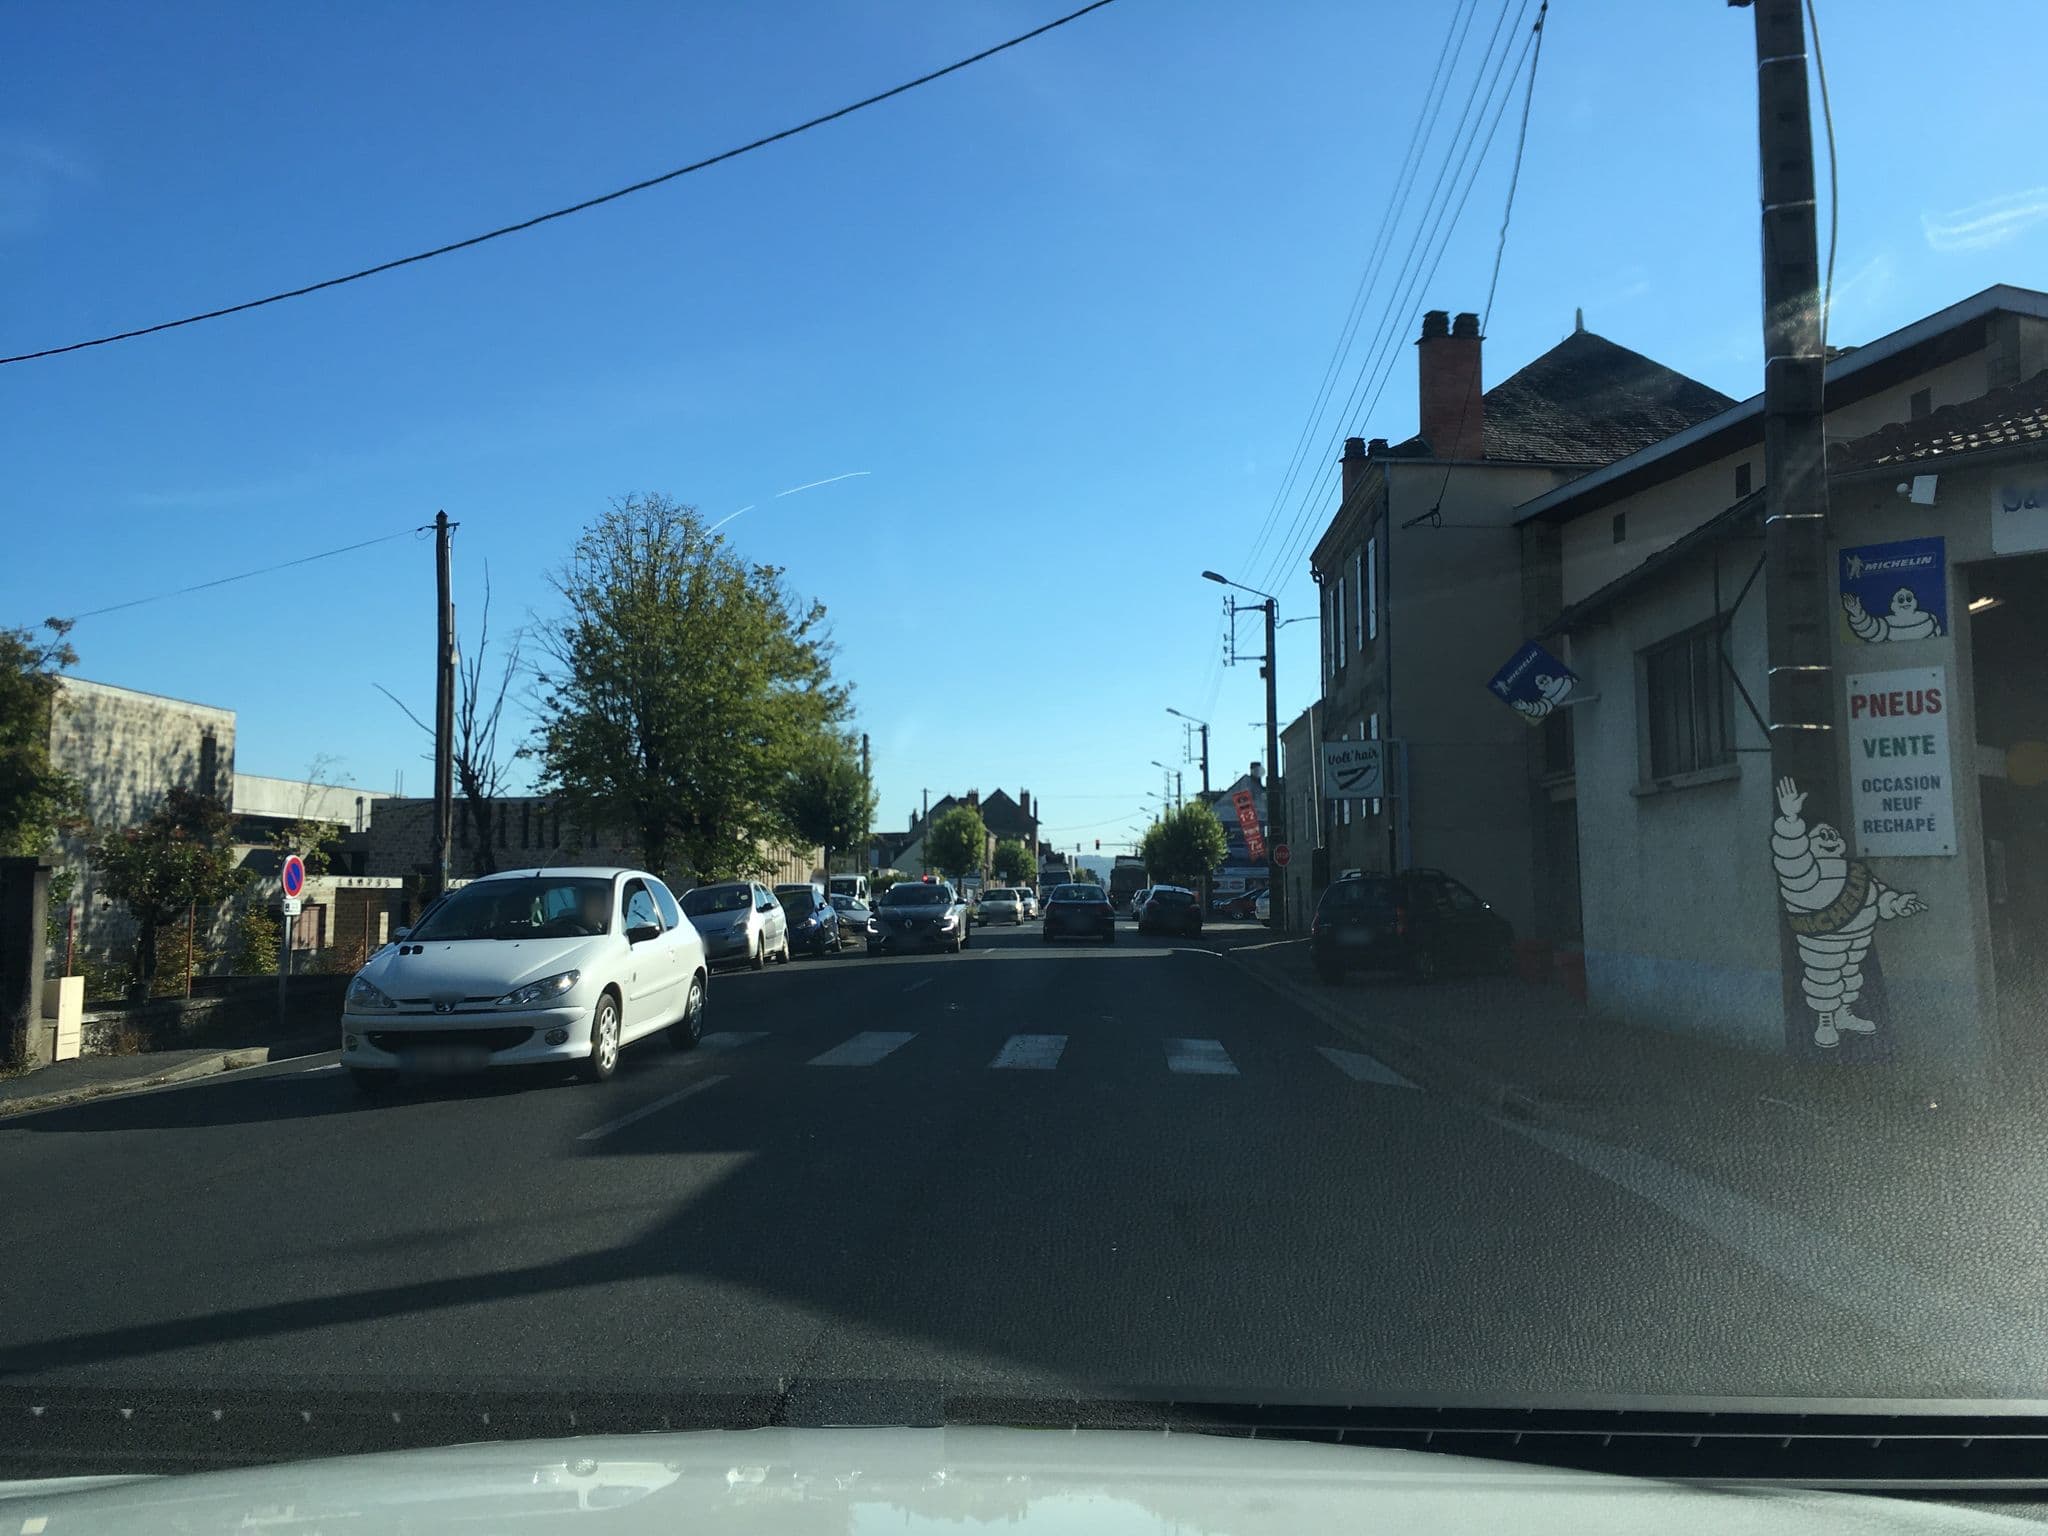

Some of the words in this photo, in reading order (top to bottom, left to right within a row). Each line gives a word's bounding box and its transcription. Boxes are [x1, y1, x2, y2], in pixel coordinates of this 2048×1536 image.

[1864, 556, 1932, 571] MICHELIN
[1507, 650, 1538, 684] MICHELIN
[1851, 688, 1943, 719] PNEUS
[1863, 734, 1937, 759] VENTE
[1861, 775, 1941, 793] OCCASION
[1882, 796, 1923, 812] NEUF
[1863, 813, 1937, 834] RECHAPÉ
